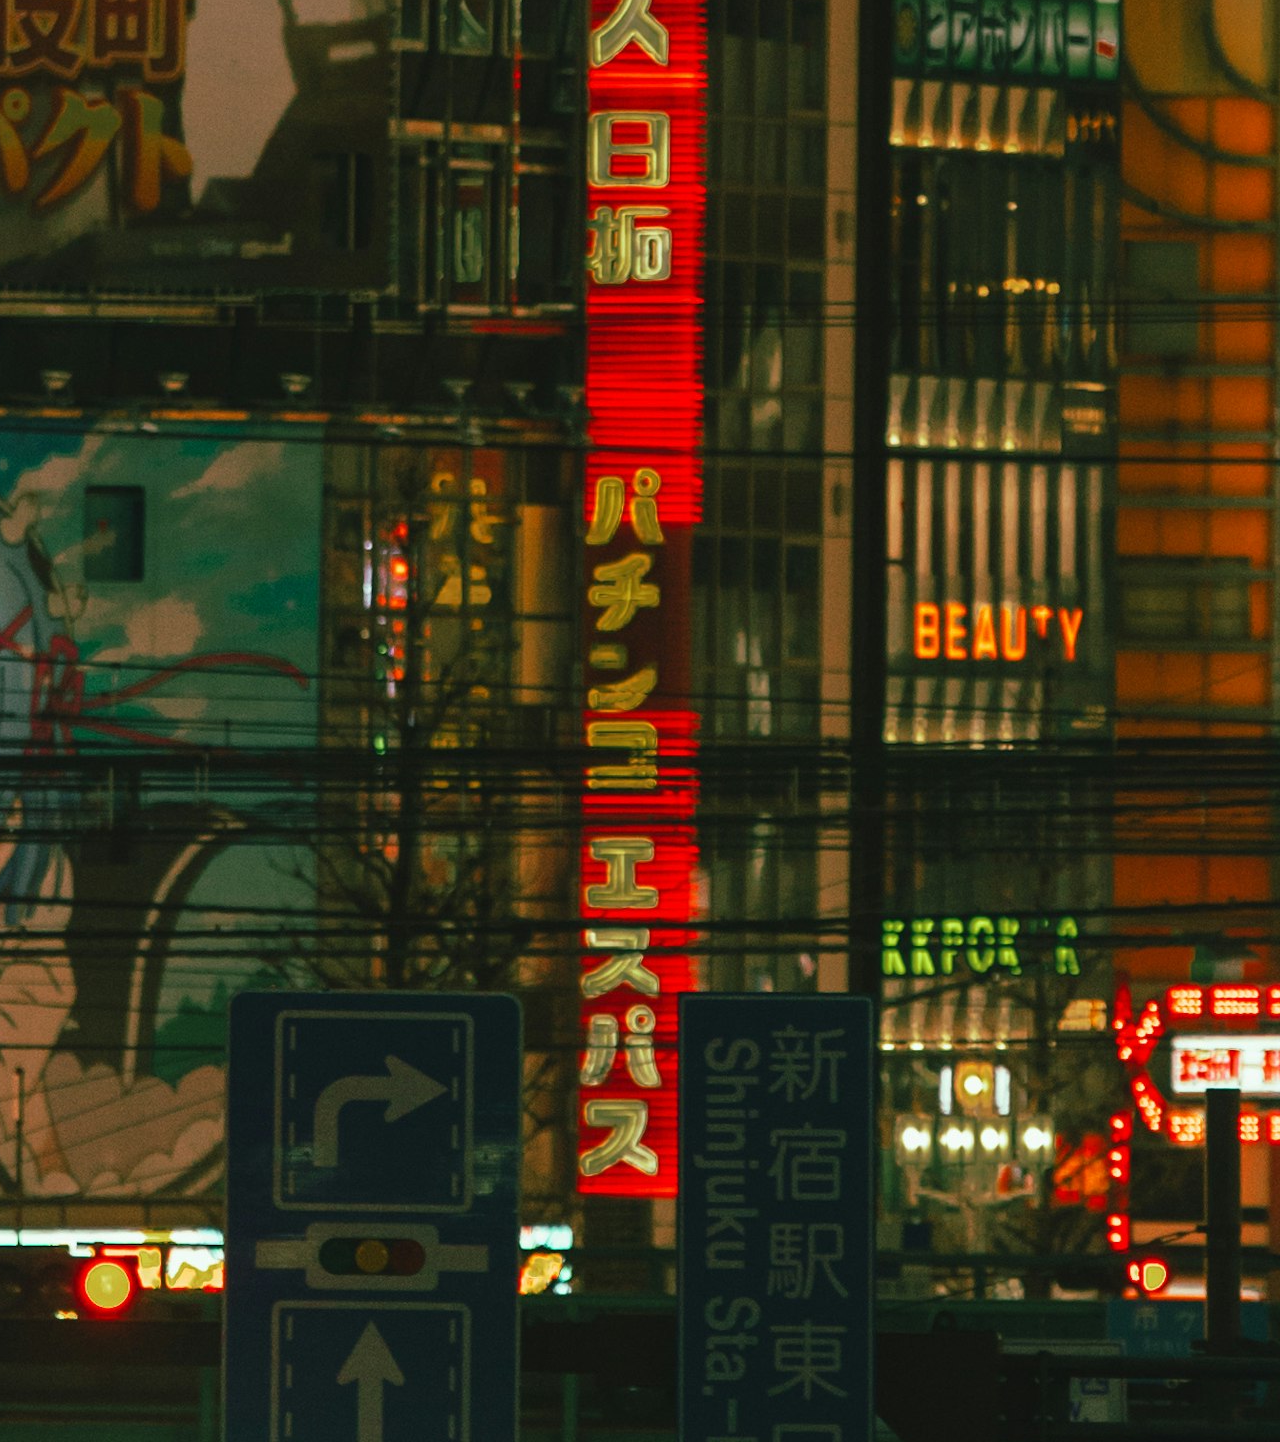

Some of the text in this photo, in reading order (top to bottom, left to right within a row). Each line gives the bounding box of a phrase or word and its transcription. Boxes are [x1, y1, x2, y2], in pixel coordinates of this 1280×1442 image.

[587, 110, 672, 285] 日拓
[585, 467, 663, 791] パチンコ
[913, 602, 1083, 662] BEAUTY
[580, 837, 662, 1179] エスパス
[693, 1035, 762, 1275] Shinjuku
